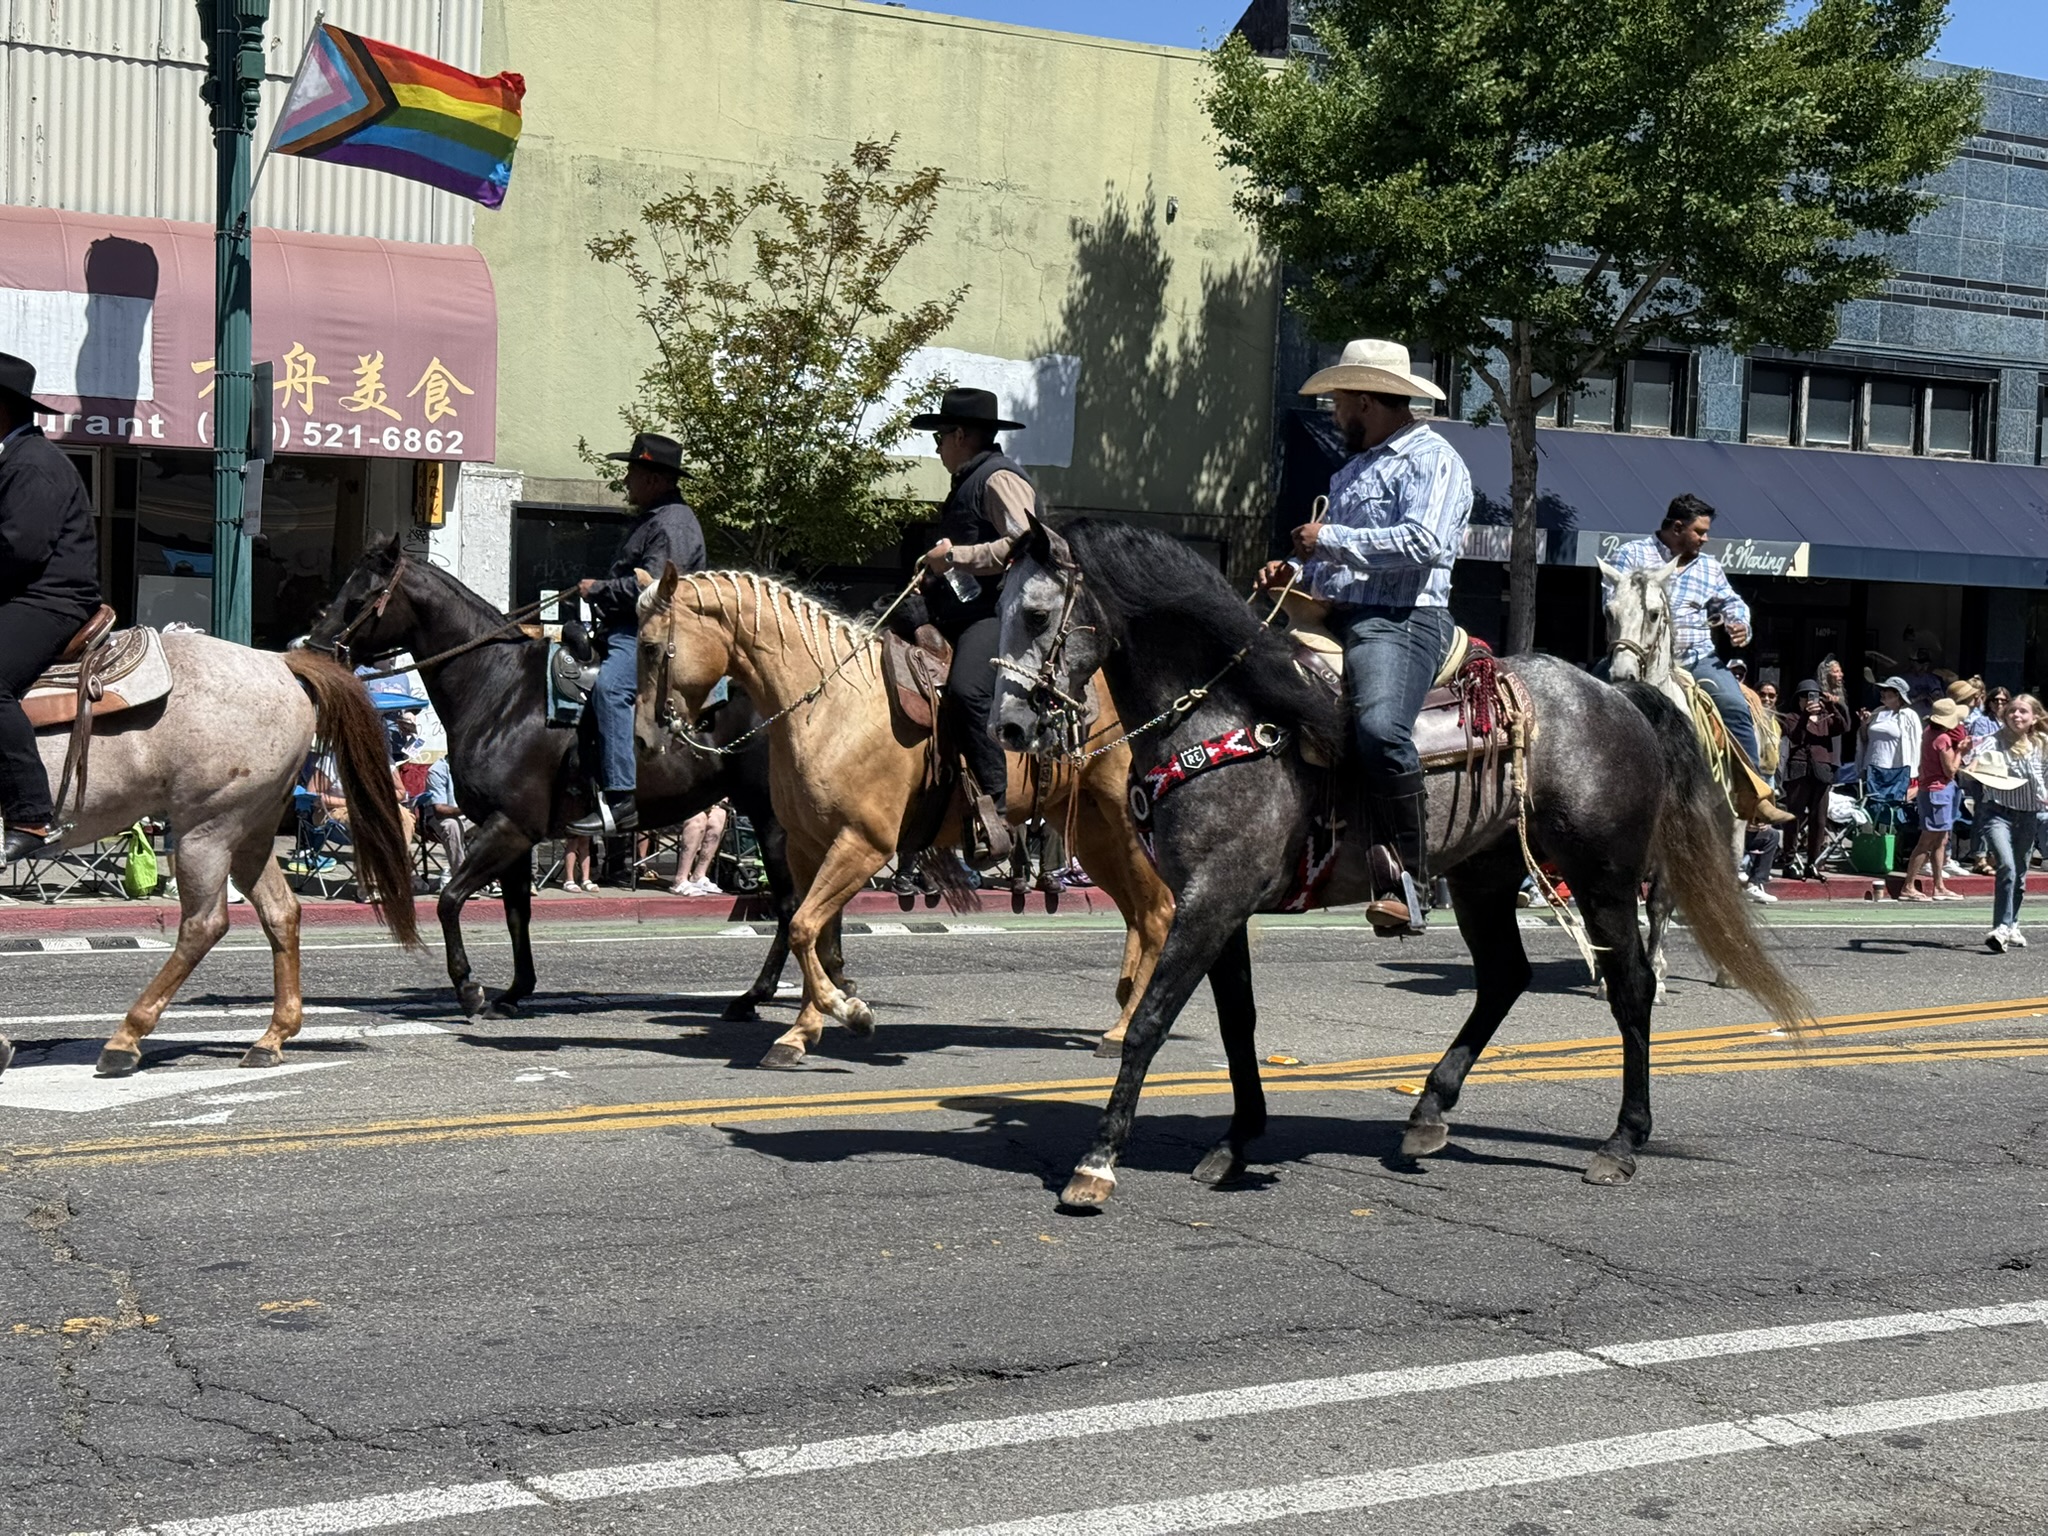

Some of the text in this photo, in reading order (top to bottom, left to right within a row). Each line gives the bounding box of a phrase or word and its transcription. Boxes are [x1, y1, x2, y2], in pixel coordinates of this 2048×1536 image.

[303, 421, 463, 454] 521-6862
[1720, 542, 1786, 575] & Waxing
